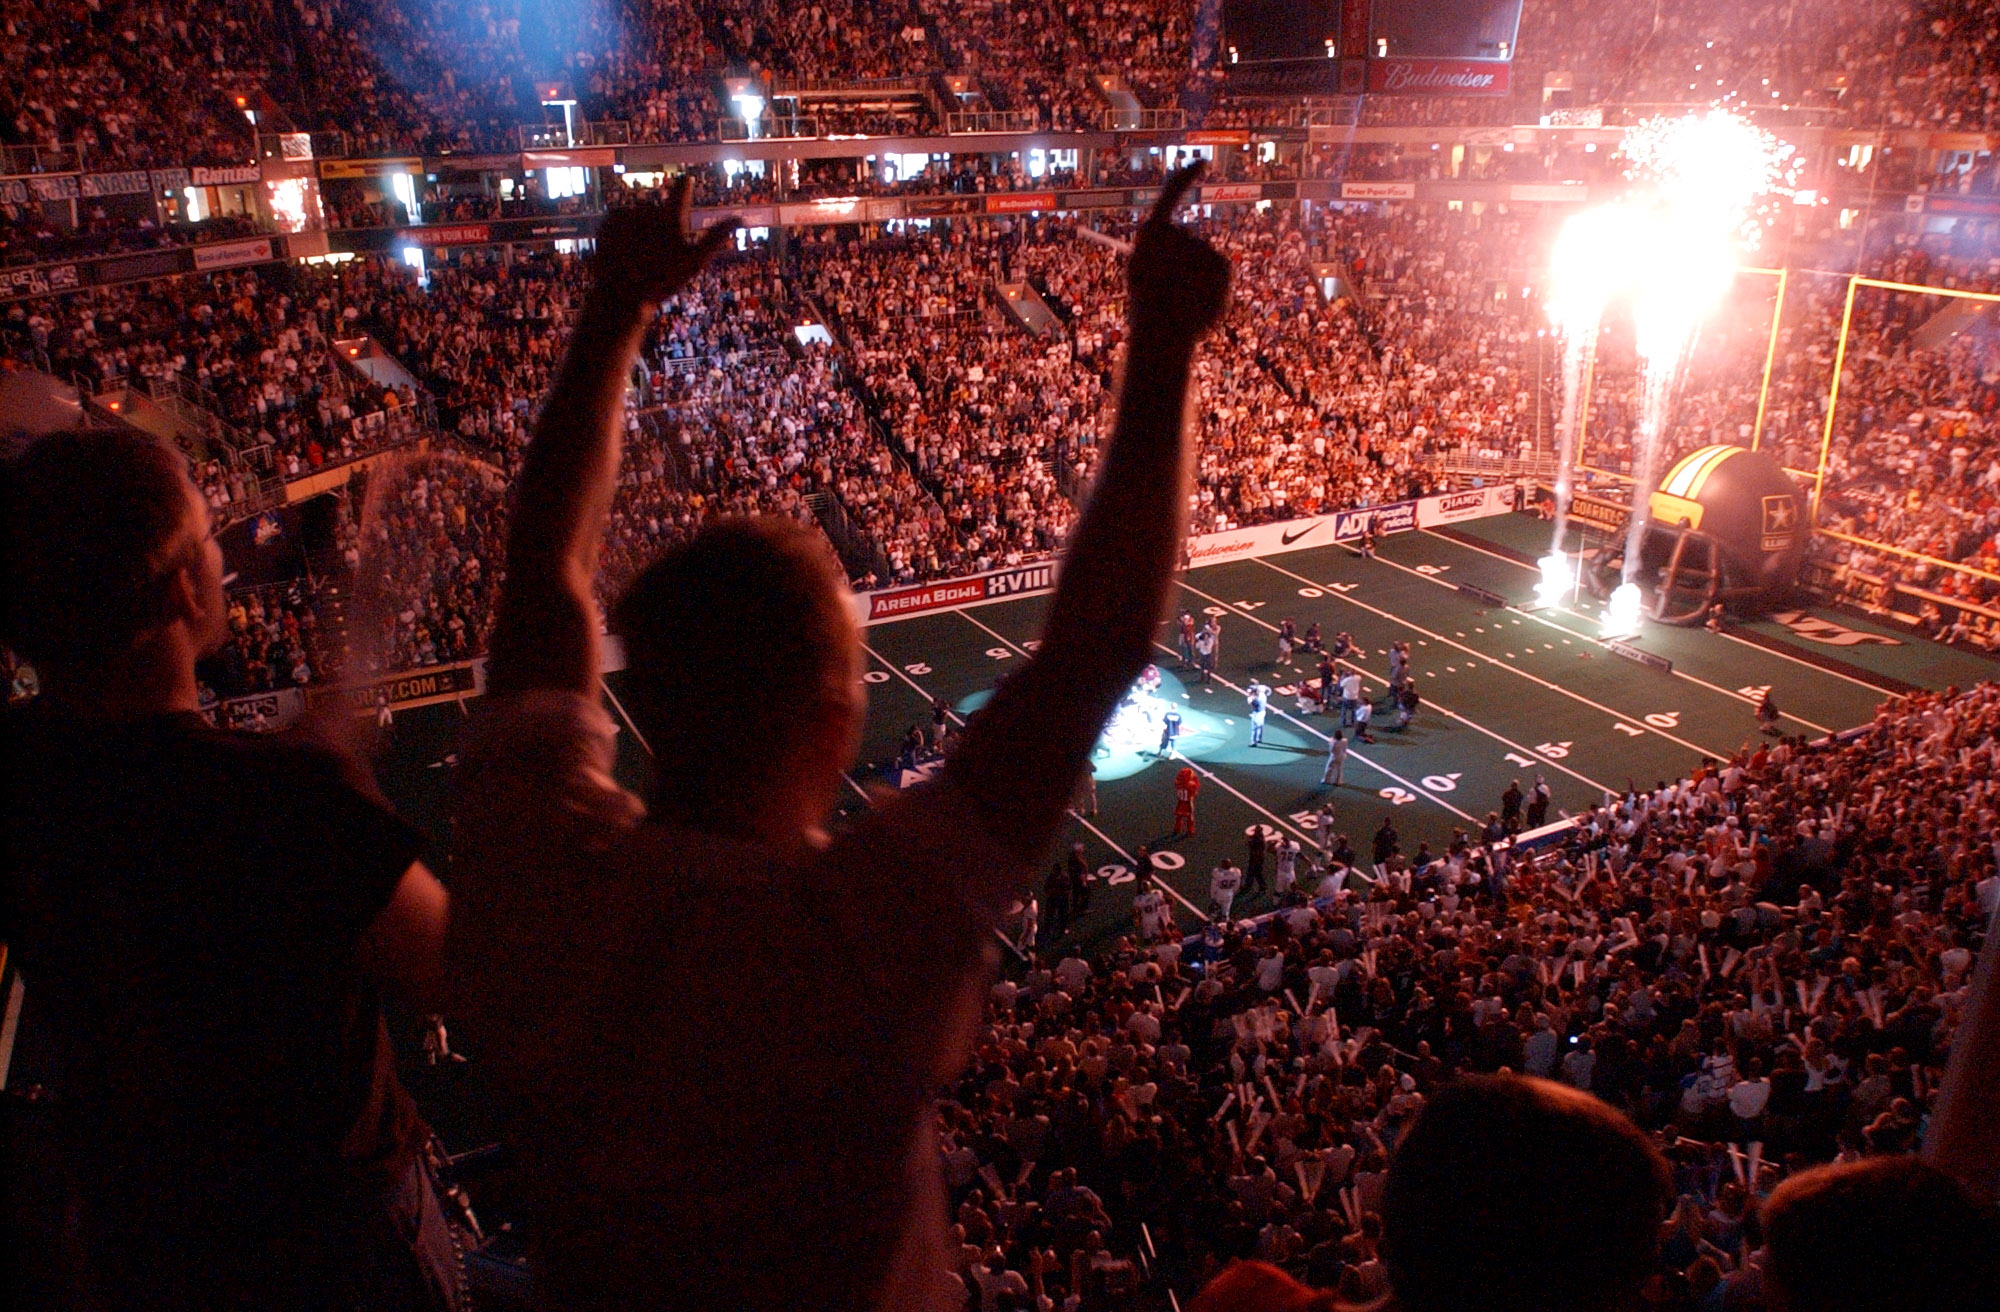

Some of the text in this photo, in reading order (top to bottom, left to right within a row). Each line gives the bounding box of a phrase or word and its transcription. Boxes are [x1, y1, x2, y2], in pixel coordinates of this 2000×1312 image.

[1385, 62, 1494, 89] Budweiser
[193, 166, 260, 185] RATTLERS
[1000, 200, 1043, 209] McDonald's
[1439, 493, 1484, 513] CHAMPS
[1337, 511, 1372, 538] ADT
[875, 568, 1049, 613] ARENA BOWL XVIII
